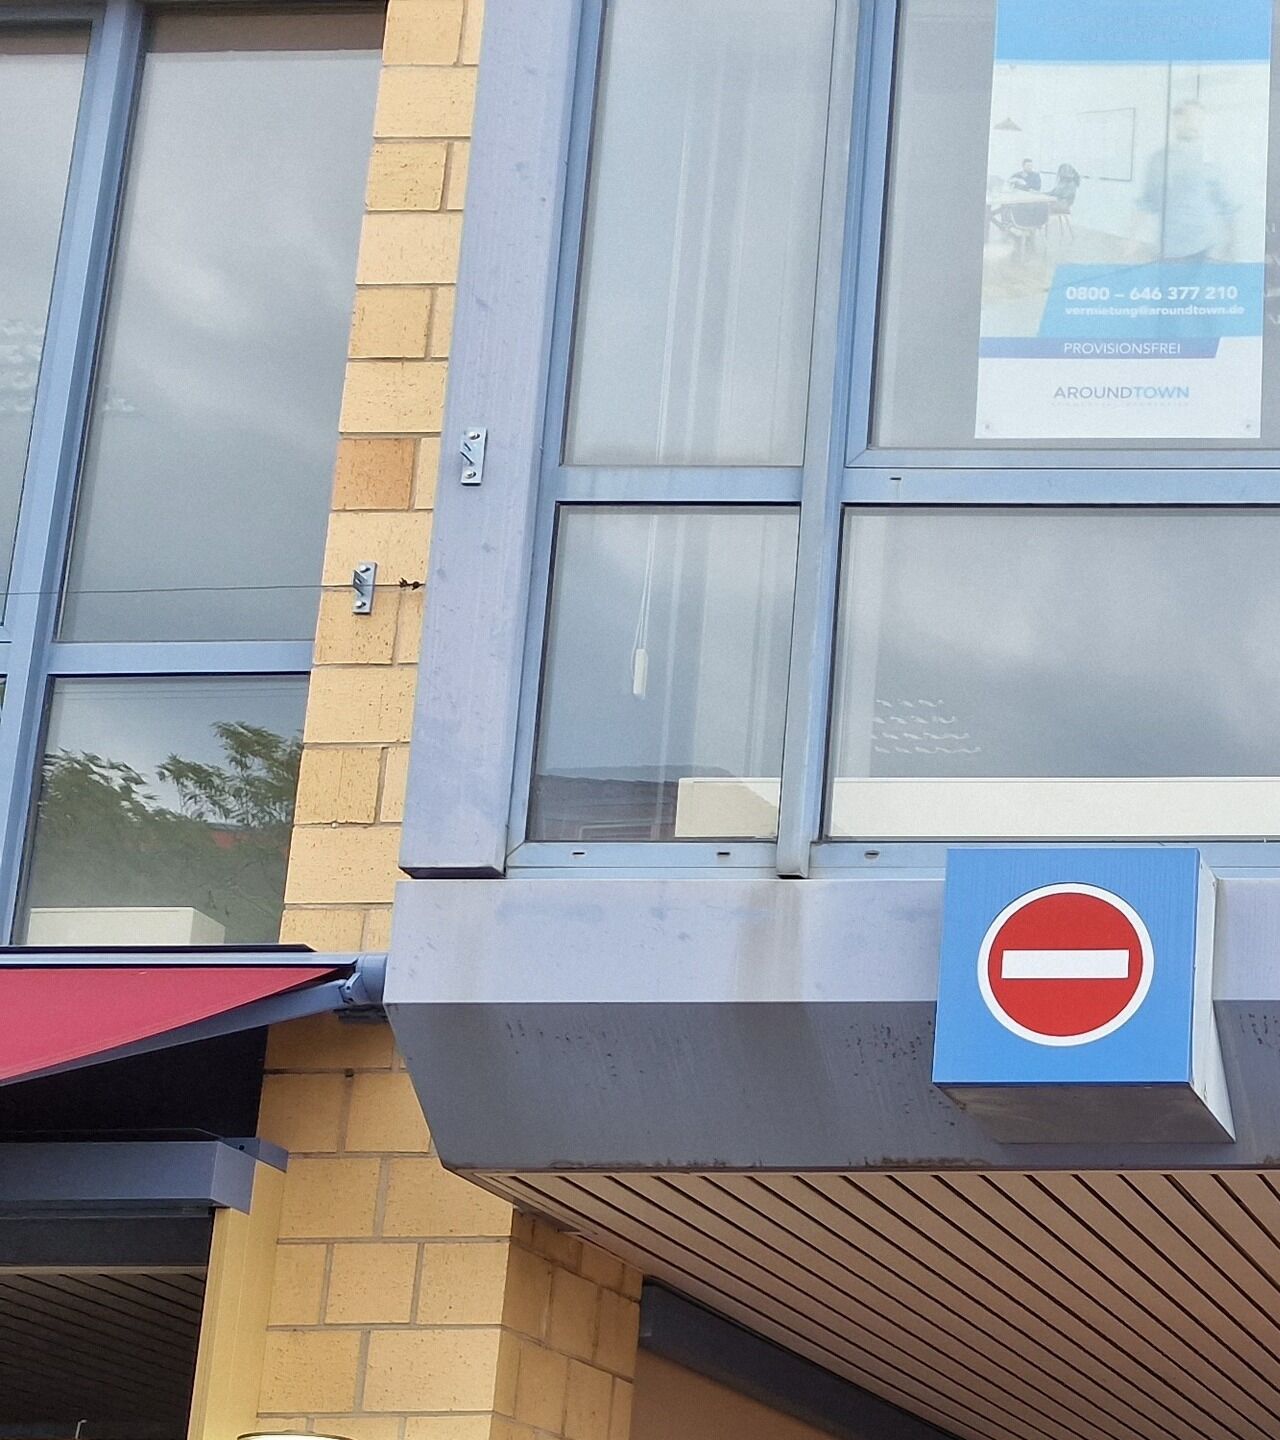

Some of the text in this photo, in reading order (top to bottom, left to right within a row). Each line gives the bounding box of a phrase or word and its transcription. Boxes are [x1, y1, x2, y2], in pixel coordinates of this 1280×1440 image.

[1065, 286, 1110, 301] 0800
[1129, 285, 1162, 301] 646
[1167, 285, 1199, 300] 377
[1204, 285, 1238, 300] 210
[1063, 342, 1182, 355] PROVISIONSFREI
[1053, 385, 1190, 400] AROUNDTOWN
